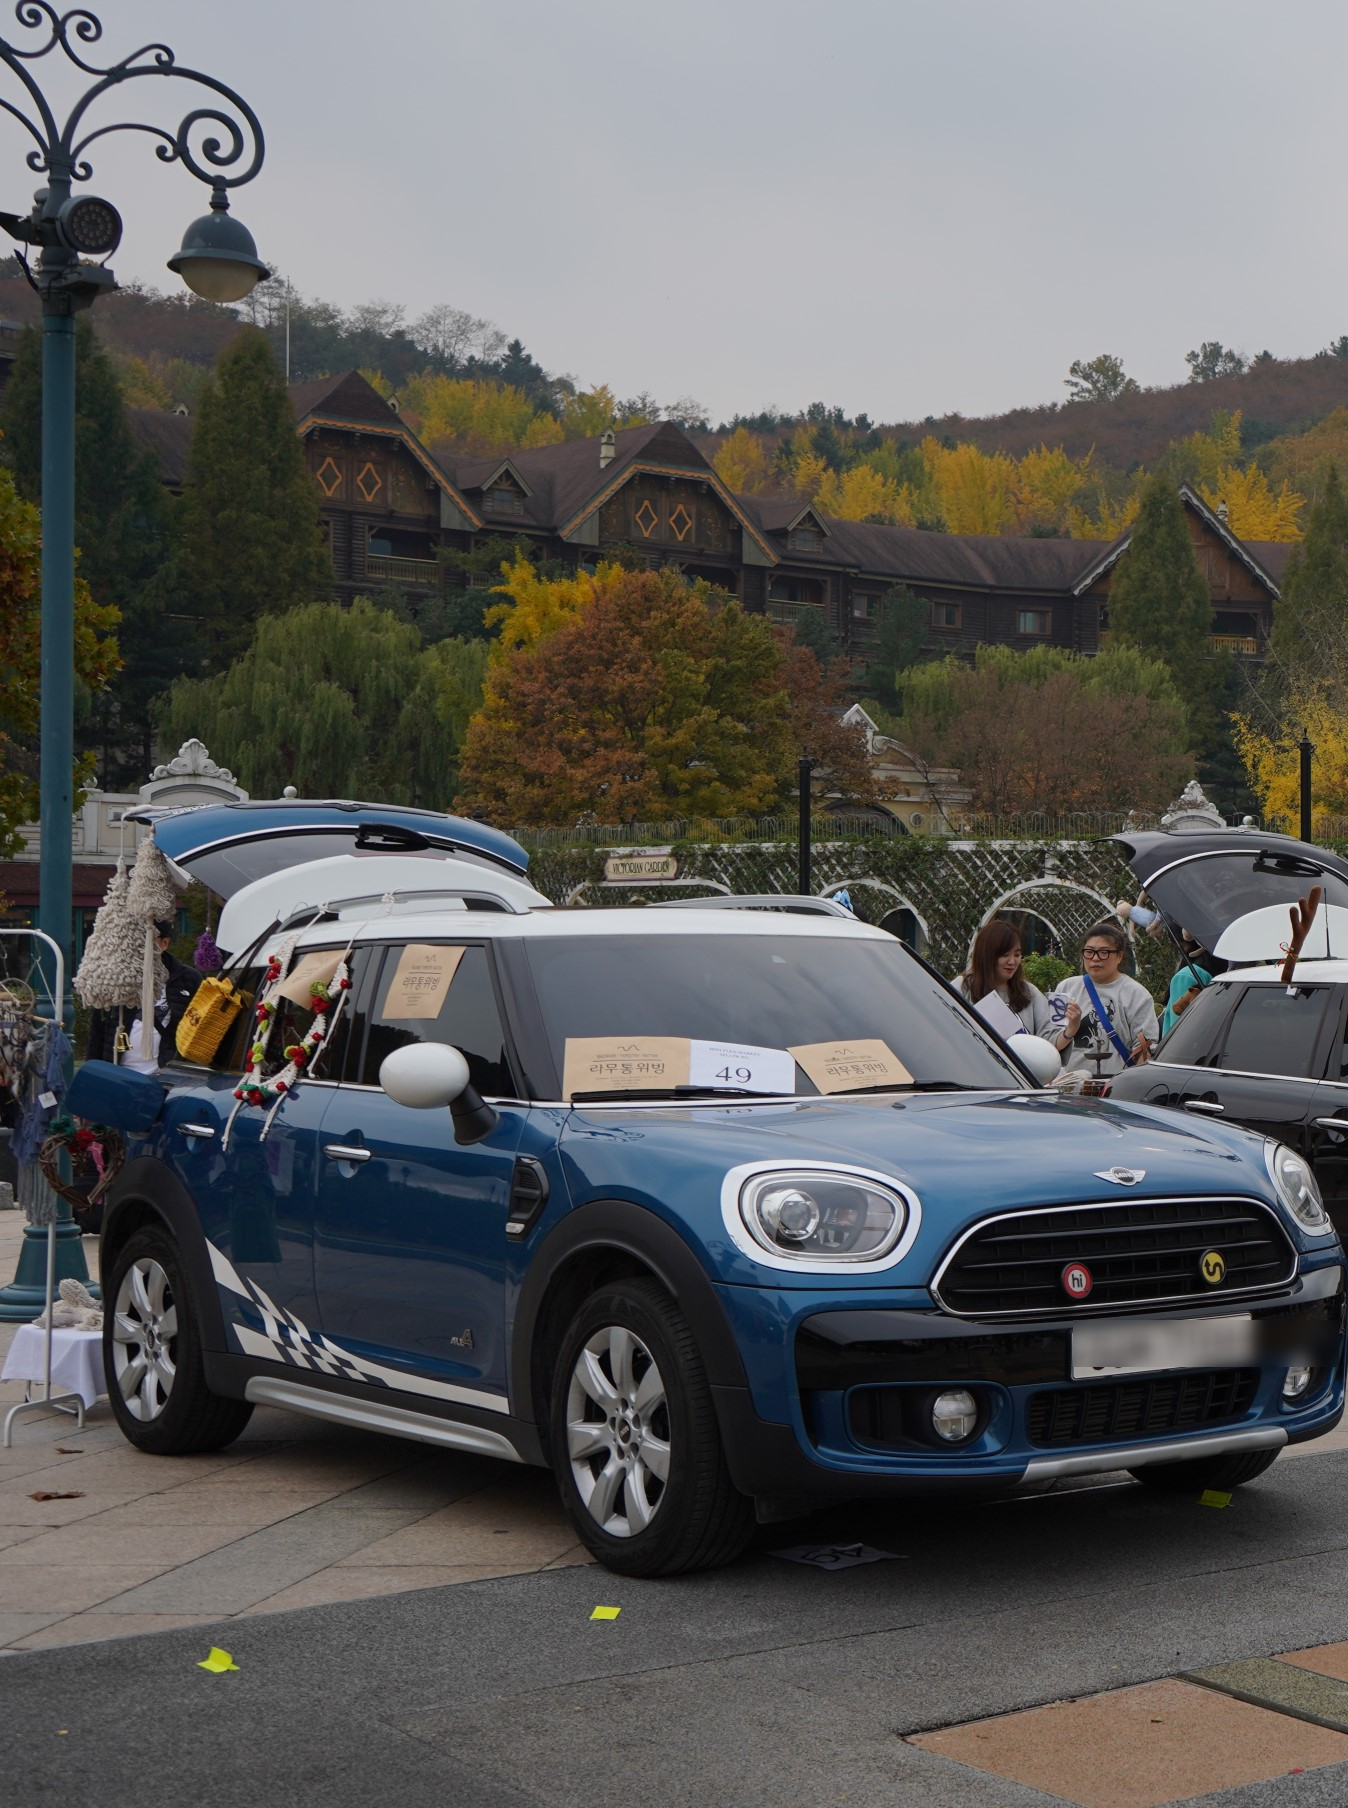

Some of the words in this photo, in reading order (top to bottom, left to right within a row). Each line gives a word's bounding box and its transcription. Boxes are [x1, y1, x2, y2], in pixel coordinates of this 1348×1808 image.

[612, 862, 643, 874] VICTORIAN
[589, 1062, 665, 1075] 라무통위빙
[714, 1066, 752, 1084] 49
[1071, 1273, 1083, 1288] hi
